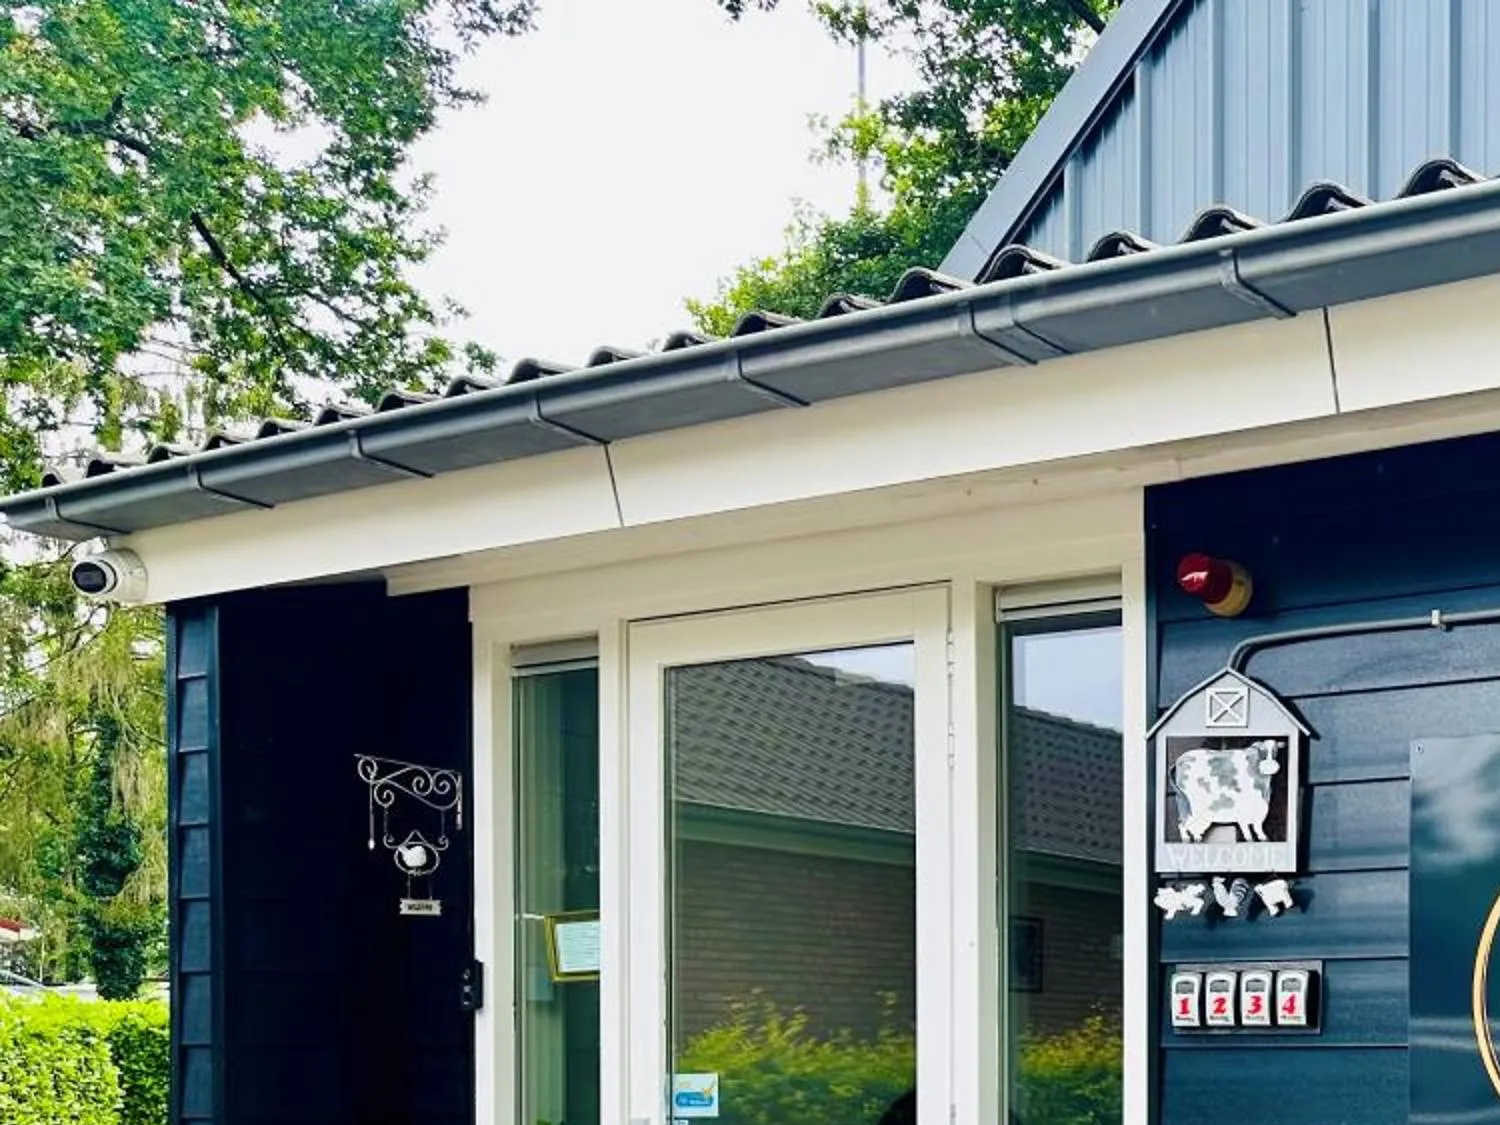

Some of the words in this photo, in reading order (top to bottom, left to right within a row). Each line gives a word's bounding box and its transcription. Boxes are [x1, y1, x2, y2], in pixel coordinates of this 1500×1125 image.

[1166, 843, 1285, 869] WELCOME
[1179, 997, 1191, 1015] 1
[1213, 997, 1227, 1015] 2
[1247, 995, 1263, 1015] 3
[1282, 993, 1297, 1015] 4
